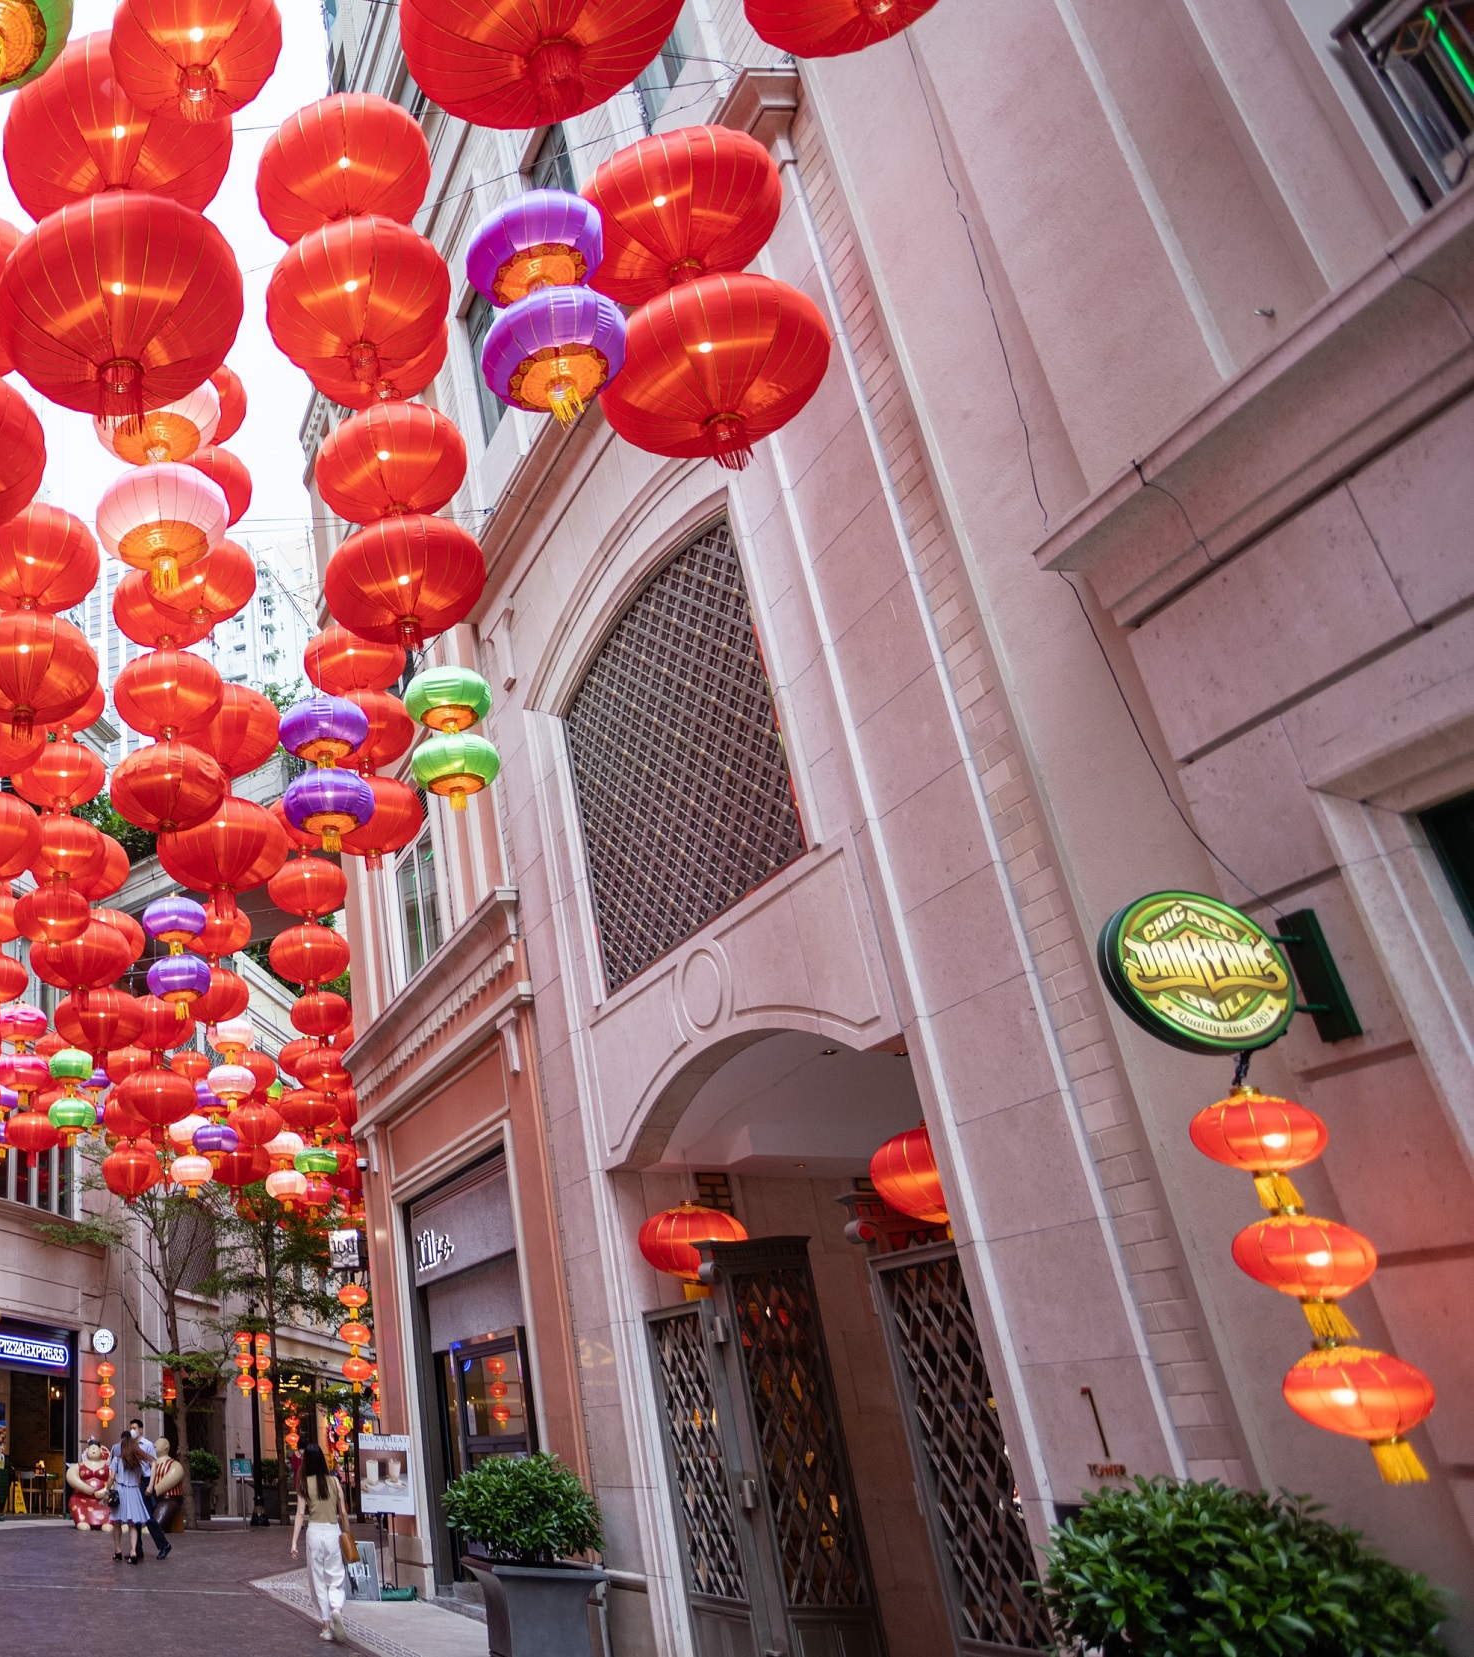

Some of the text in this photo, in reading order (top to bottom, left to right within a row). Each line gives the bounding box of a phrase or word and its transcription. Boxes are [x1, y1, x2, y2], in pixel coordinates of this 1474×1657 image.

[1142, 905, 1238, 942] CHICAGO
[1178, 989, 1251, 1020] GRILL
[1177, 1010, 1271, 1035] Quality since 1989
[359, 1434, 408, 1444] BUCKWHEAT
